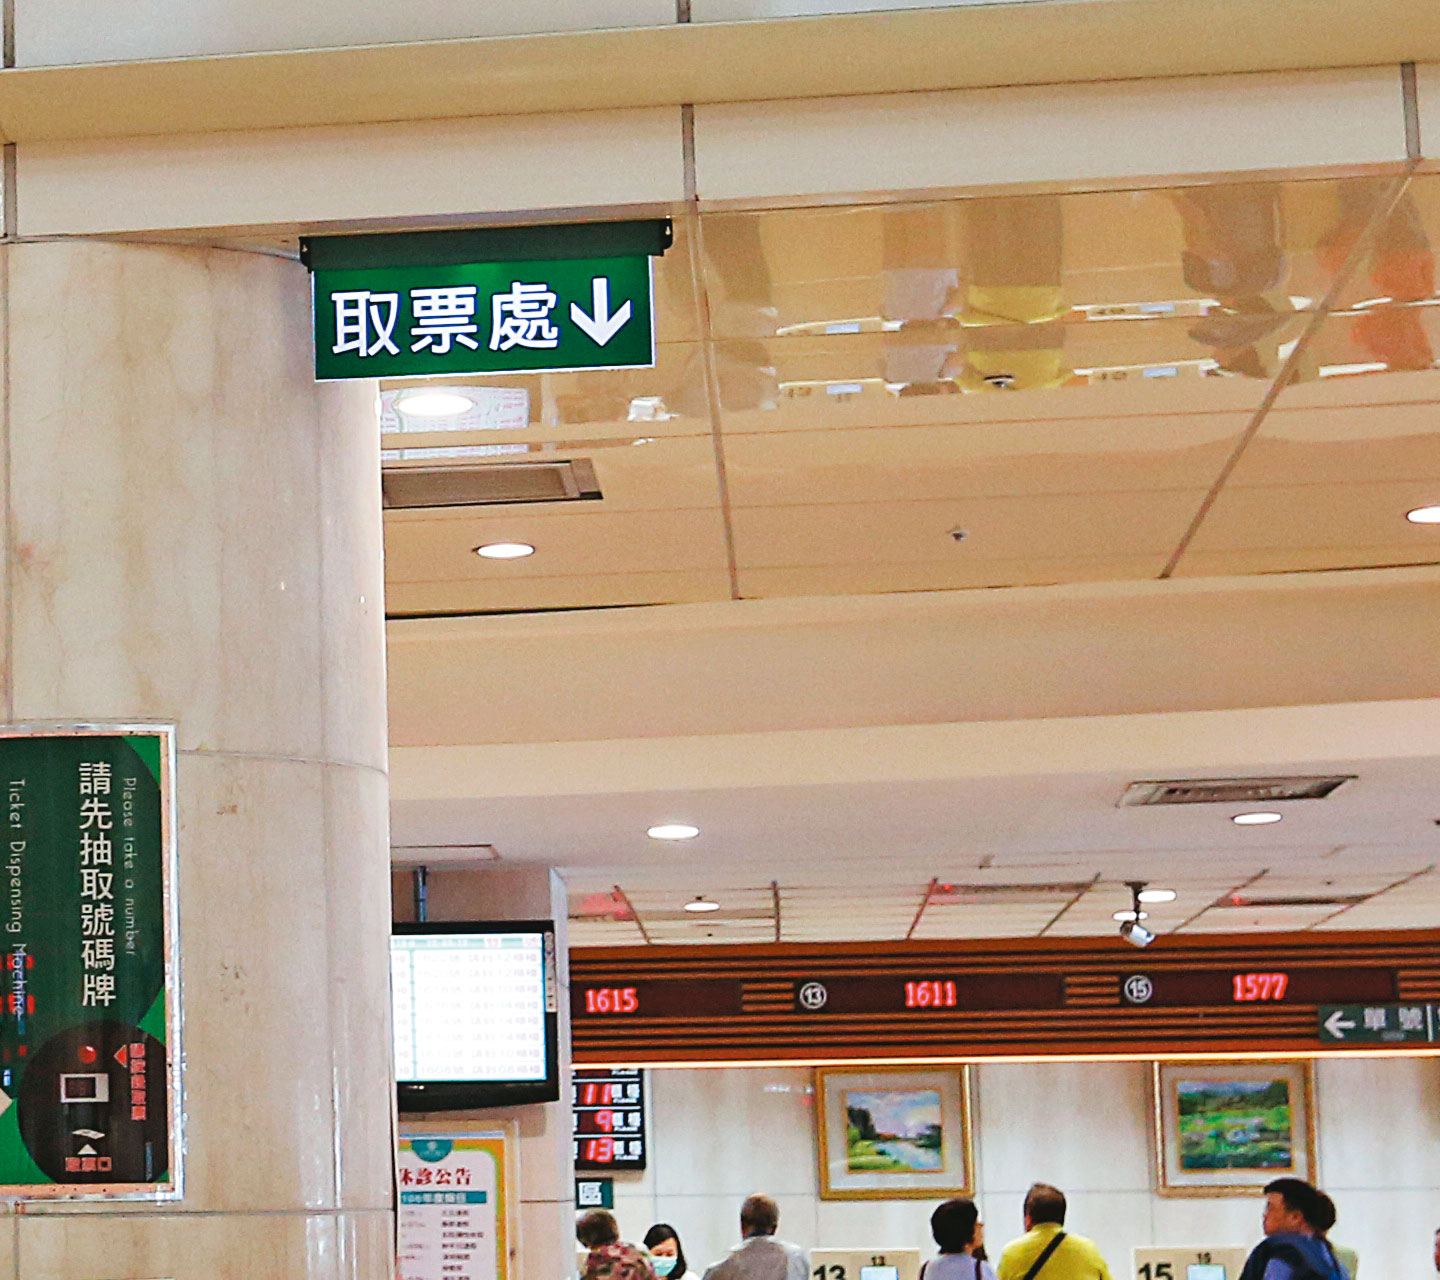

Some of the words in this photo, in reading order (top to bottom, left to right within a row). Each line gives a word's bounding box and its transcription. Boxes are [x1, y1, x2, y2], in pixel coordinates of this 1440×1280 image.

[331, 281, 559, 357] 取票處
[8, 778, 25, 831] Ticket
[123, 777, 137, 827] Please
[124, 841, 134, 870] take
[6, 840, 26, 933] Dispensing
[79, 761, 116, 1007] 請先抽取號碼牌
[125, 900, 136, 955] number
[12, 943, 27, 1017] Machine
[905, 981, 956, 1007] 1611
[1233, 973, 1288, 1001] 1577
[586, 988, 638, 1013] 1615
[585, 1082, 611, 1104] 11
[594, 1108, 613, 1132] 9
[587, 1137, 614, 1161] 13
